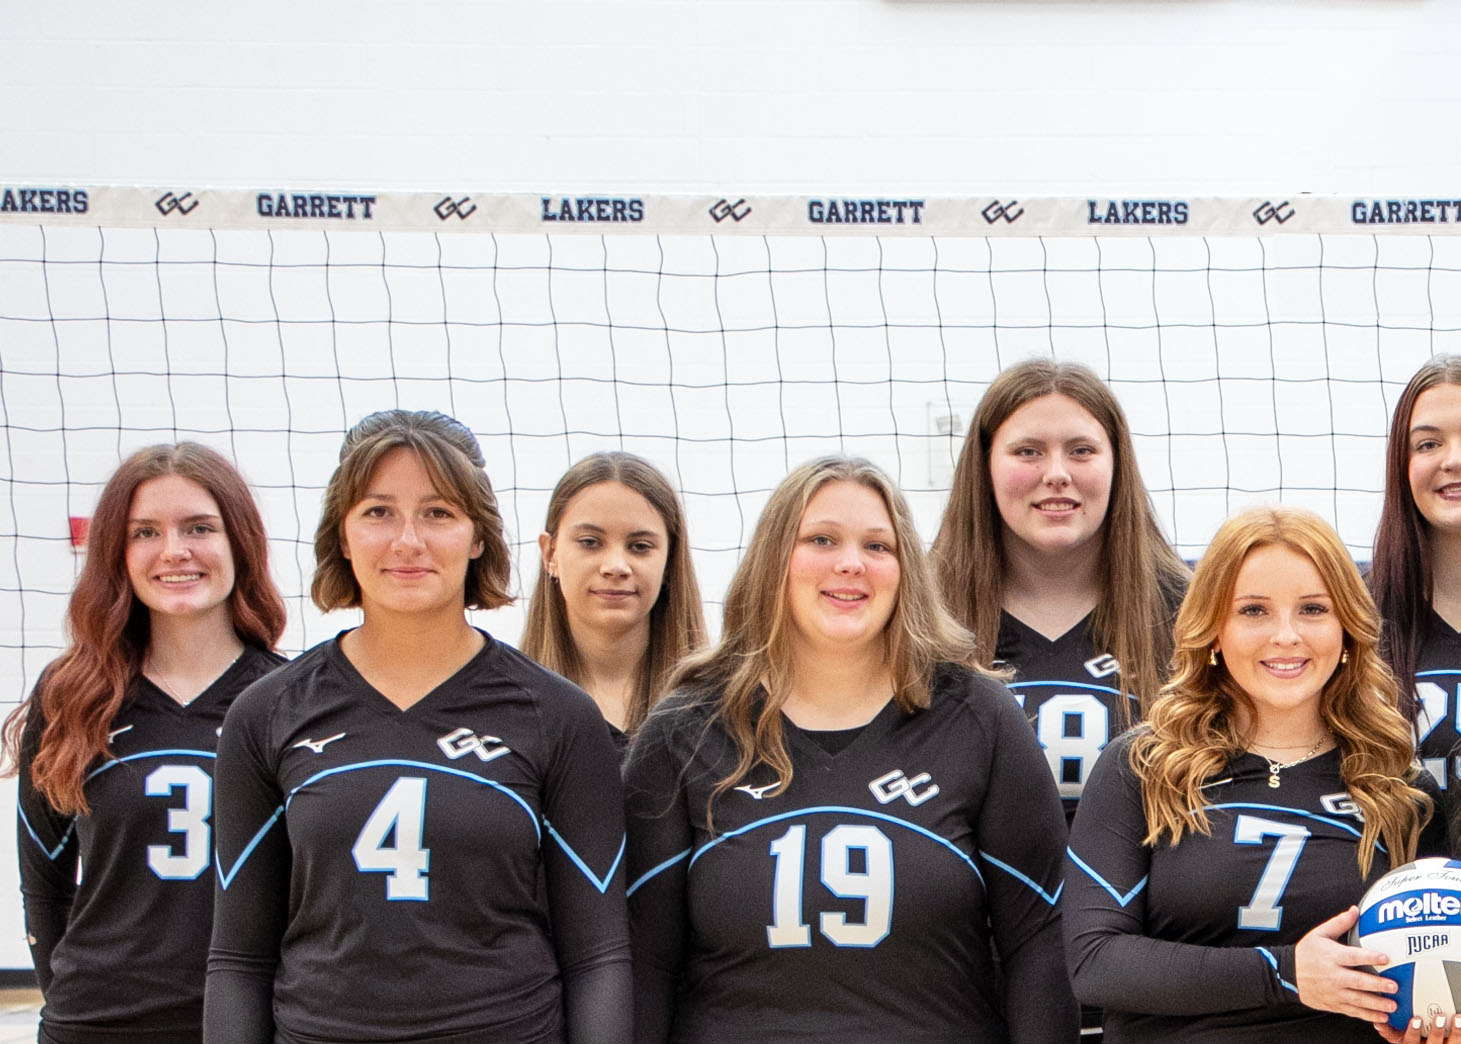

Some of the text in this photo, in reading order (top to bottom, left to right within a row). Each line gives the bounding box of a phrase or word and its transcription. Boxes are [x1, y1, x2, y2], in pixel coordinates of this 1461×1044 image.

[257, 194, 376, 219] GARRETT
[542, 198, 644, 222] LAKERS
[808, 200, 924, 224] GARRETT
[1088, 201, 1189, 225] LAKERS
[1013, 693, 1110, 801] 8
[145, 764, 213, 881] 3
[351, 776, 431, 901] 4
[1234, 814, 1312, 932] 7
[766, 824, 896, 950] 19
[1407, 934, 1449, 956] NJCAA
